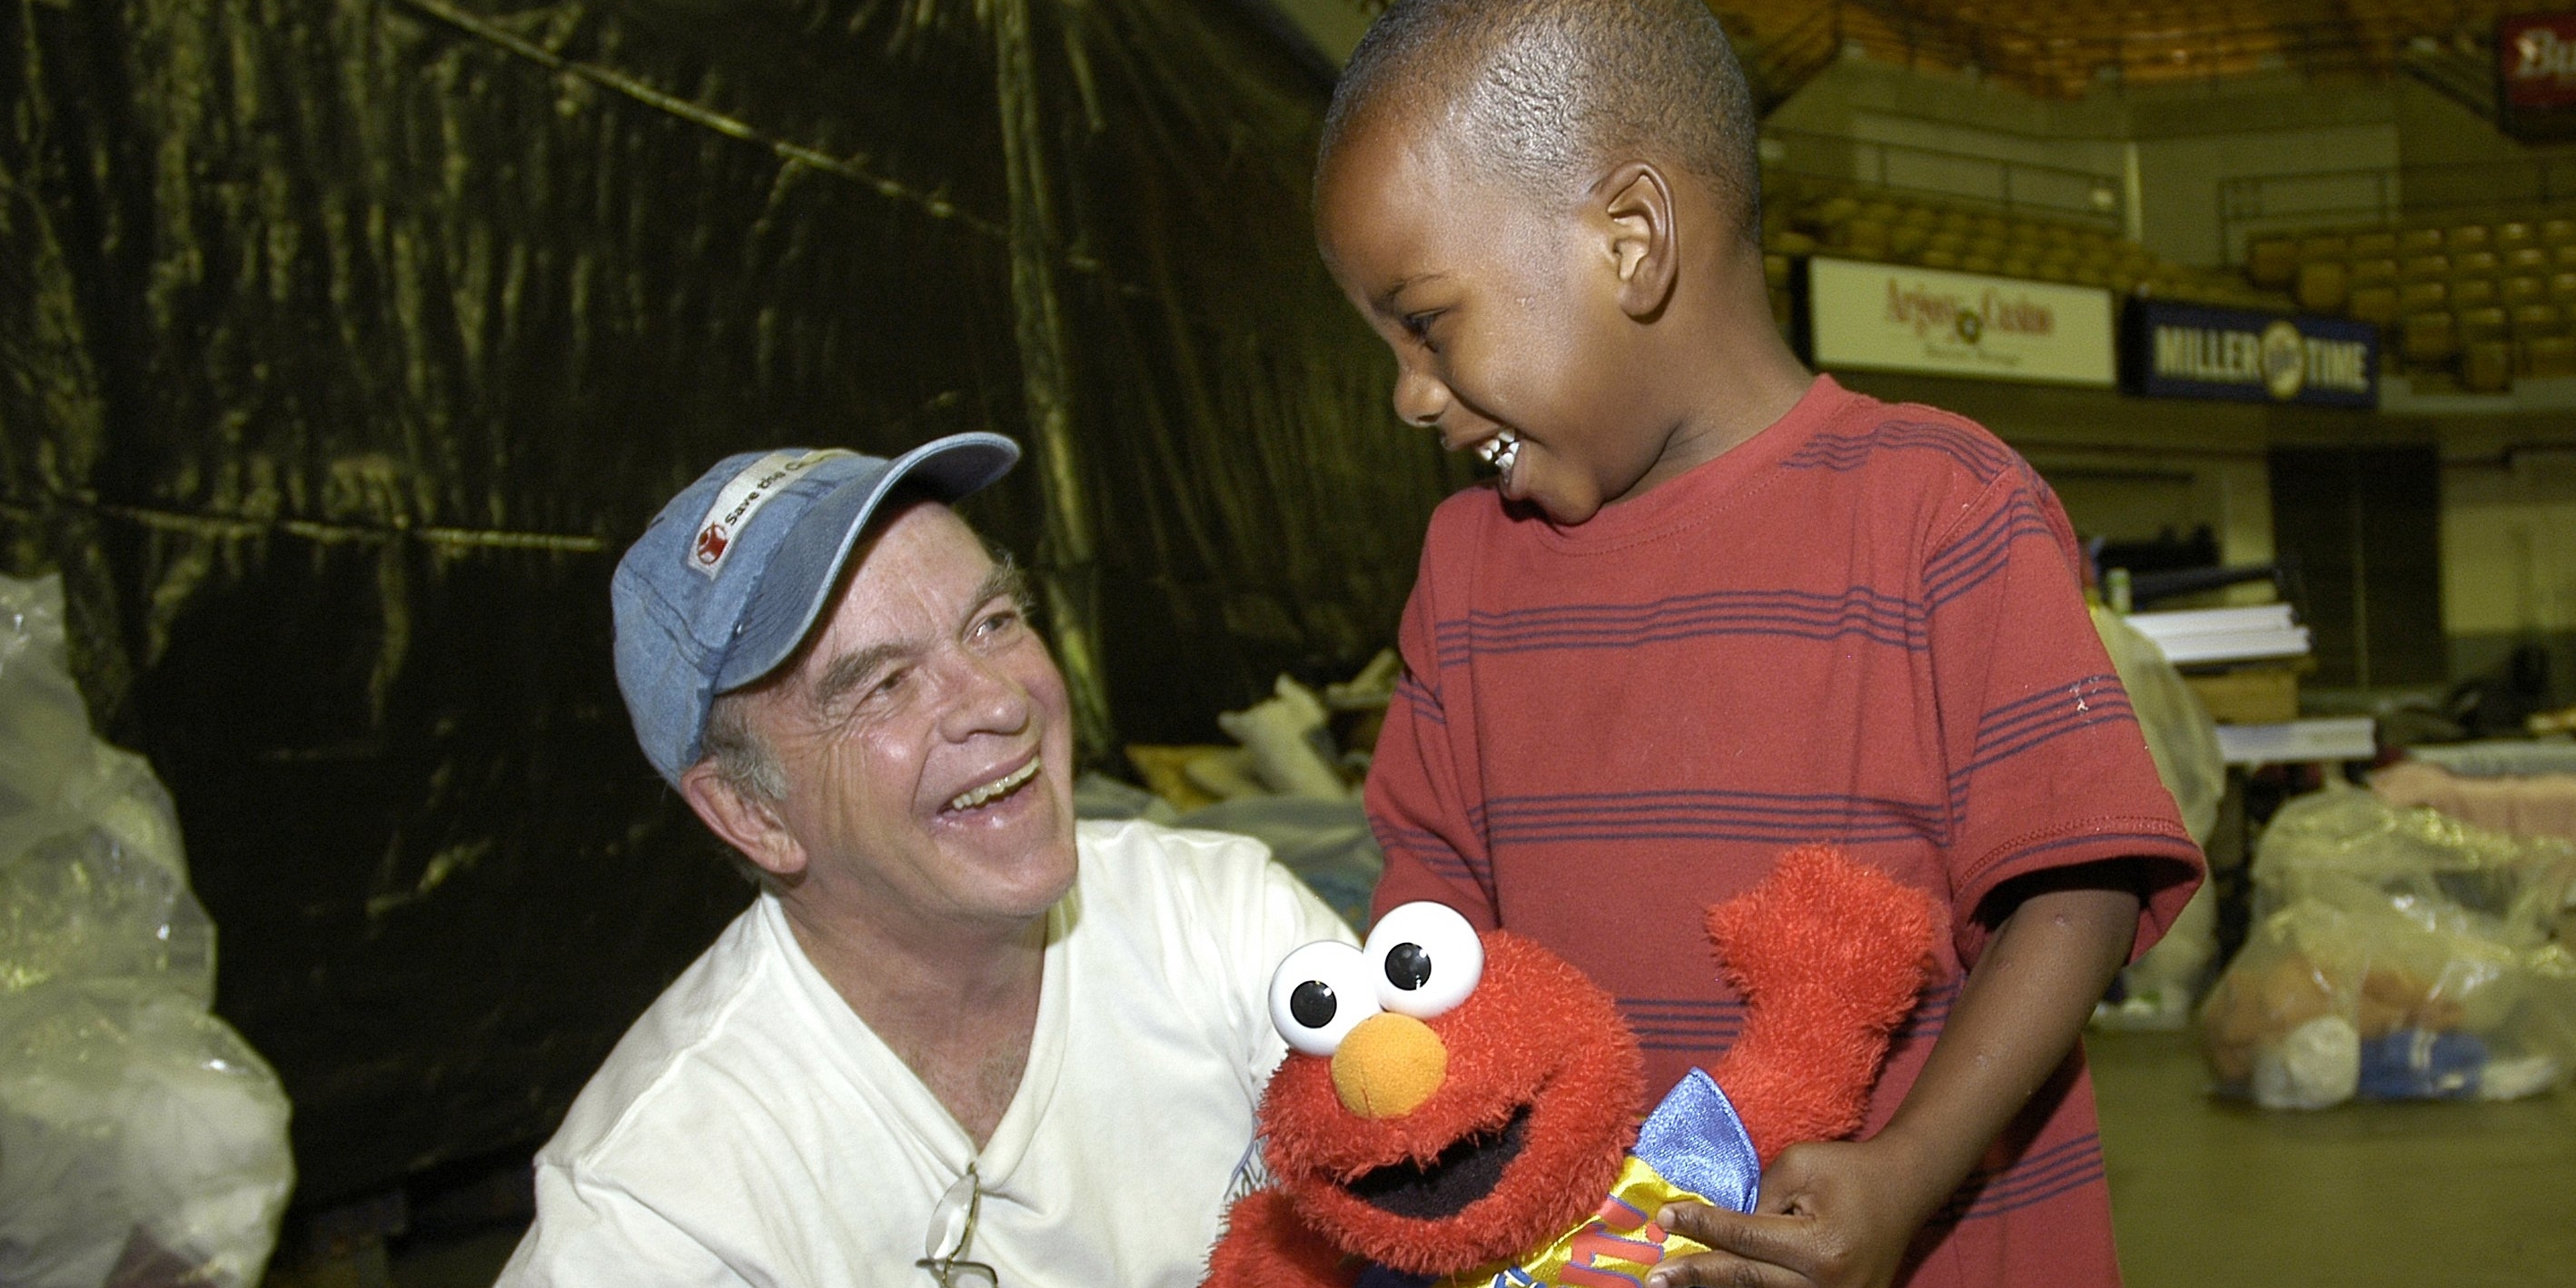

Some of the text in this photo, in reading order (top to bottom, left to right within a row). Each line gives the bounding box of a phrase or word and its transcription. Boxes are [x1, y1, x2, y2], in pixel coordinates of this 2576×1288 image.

[2154, 325, 2263, 384] MILLER
[2304, 336, 2369, 394] TIME
[725, 470, 786, 526] Save the
